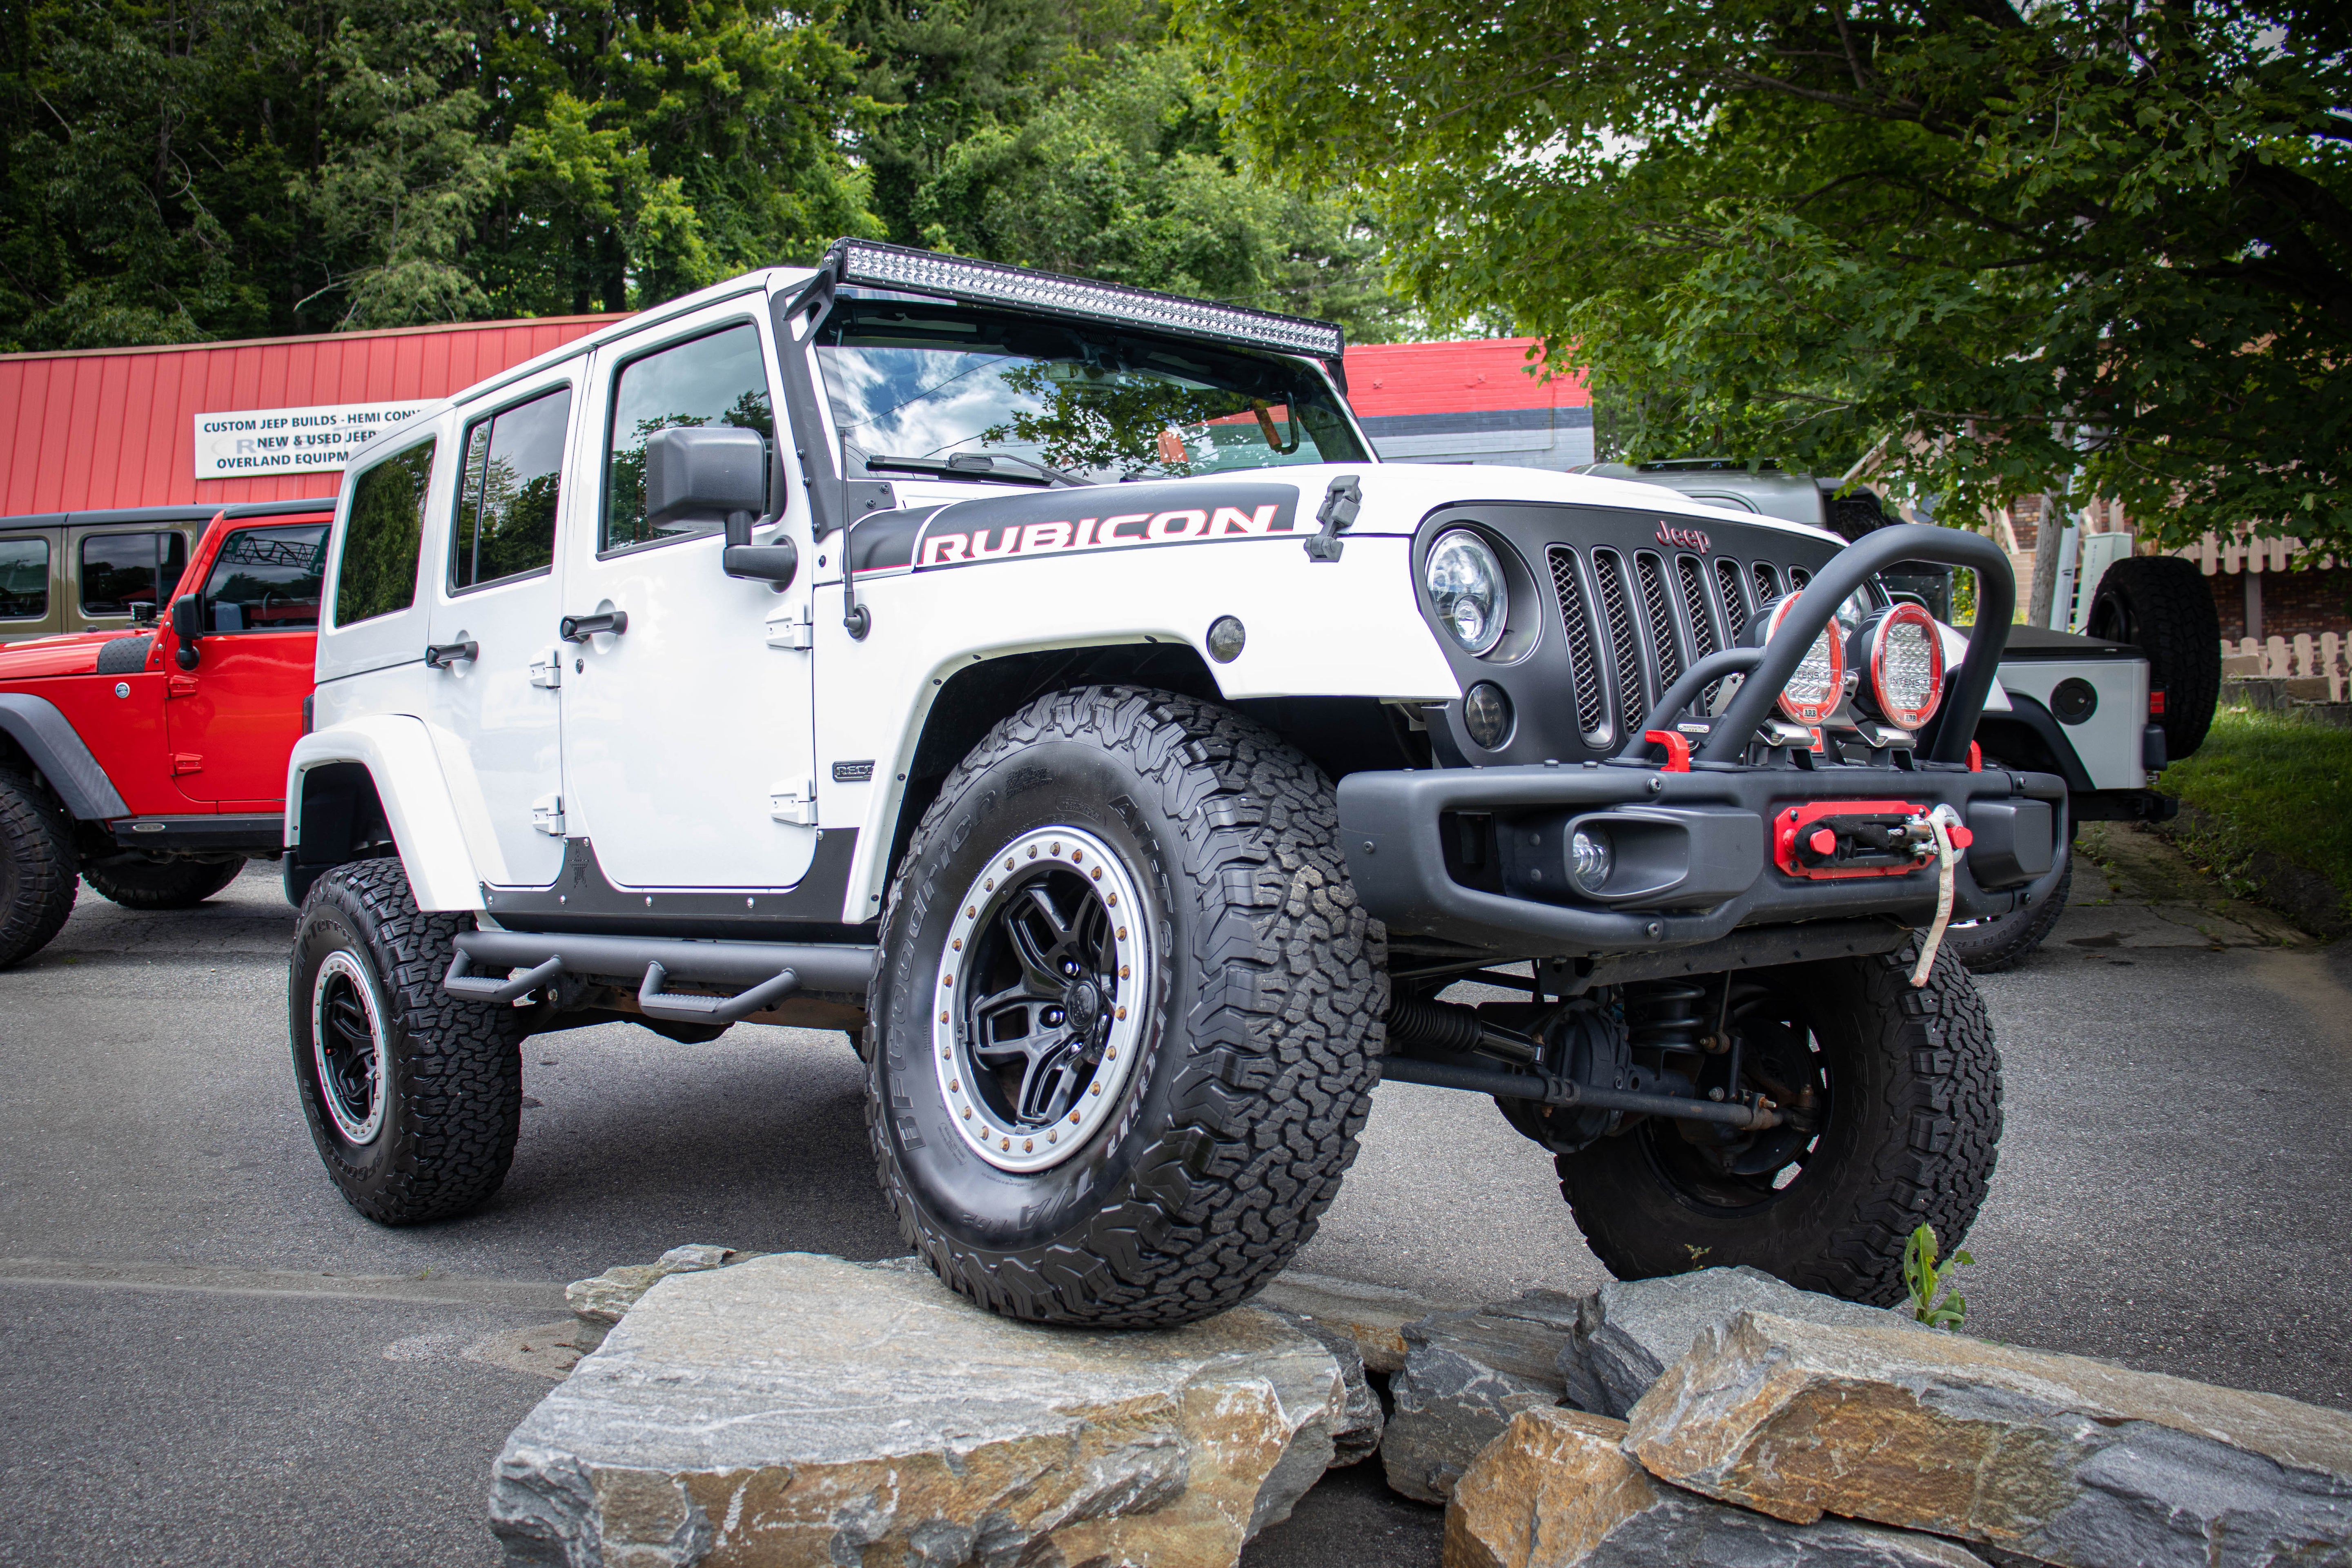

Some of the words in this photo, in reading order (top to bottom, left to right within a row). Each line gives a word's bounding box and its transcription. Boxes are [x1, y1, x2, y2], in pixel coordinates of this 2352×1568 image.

[204, 420, 256, 432] CUSTOM
[260, 418, 288, 429] JEEP
[292, 415, 337, 427] BUILDS
[347, 412, 380, 423] HEMI
[258, 436, 289, 448] NEW
[294, 435, 303, 446] &
[307, 434, 342, 445] USED
[217, 454, 291, 469] OVERLAND
[917, 505, 1292, 568] RUBICON
[1655, 520, 1711, 555] Jeep
[1792, 671, 1834, 679] TENSITY
[1890, 677, 1934, 688] INTENSITY
[836, 766, 873, 775] RECO
[1946, 911, 2029, 949] COUNTR
[297, 919, 366, 981] All-Terrain
[887, 790, 996, 1152] BFGoodrich
